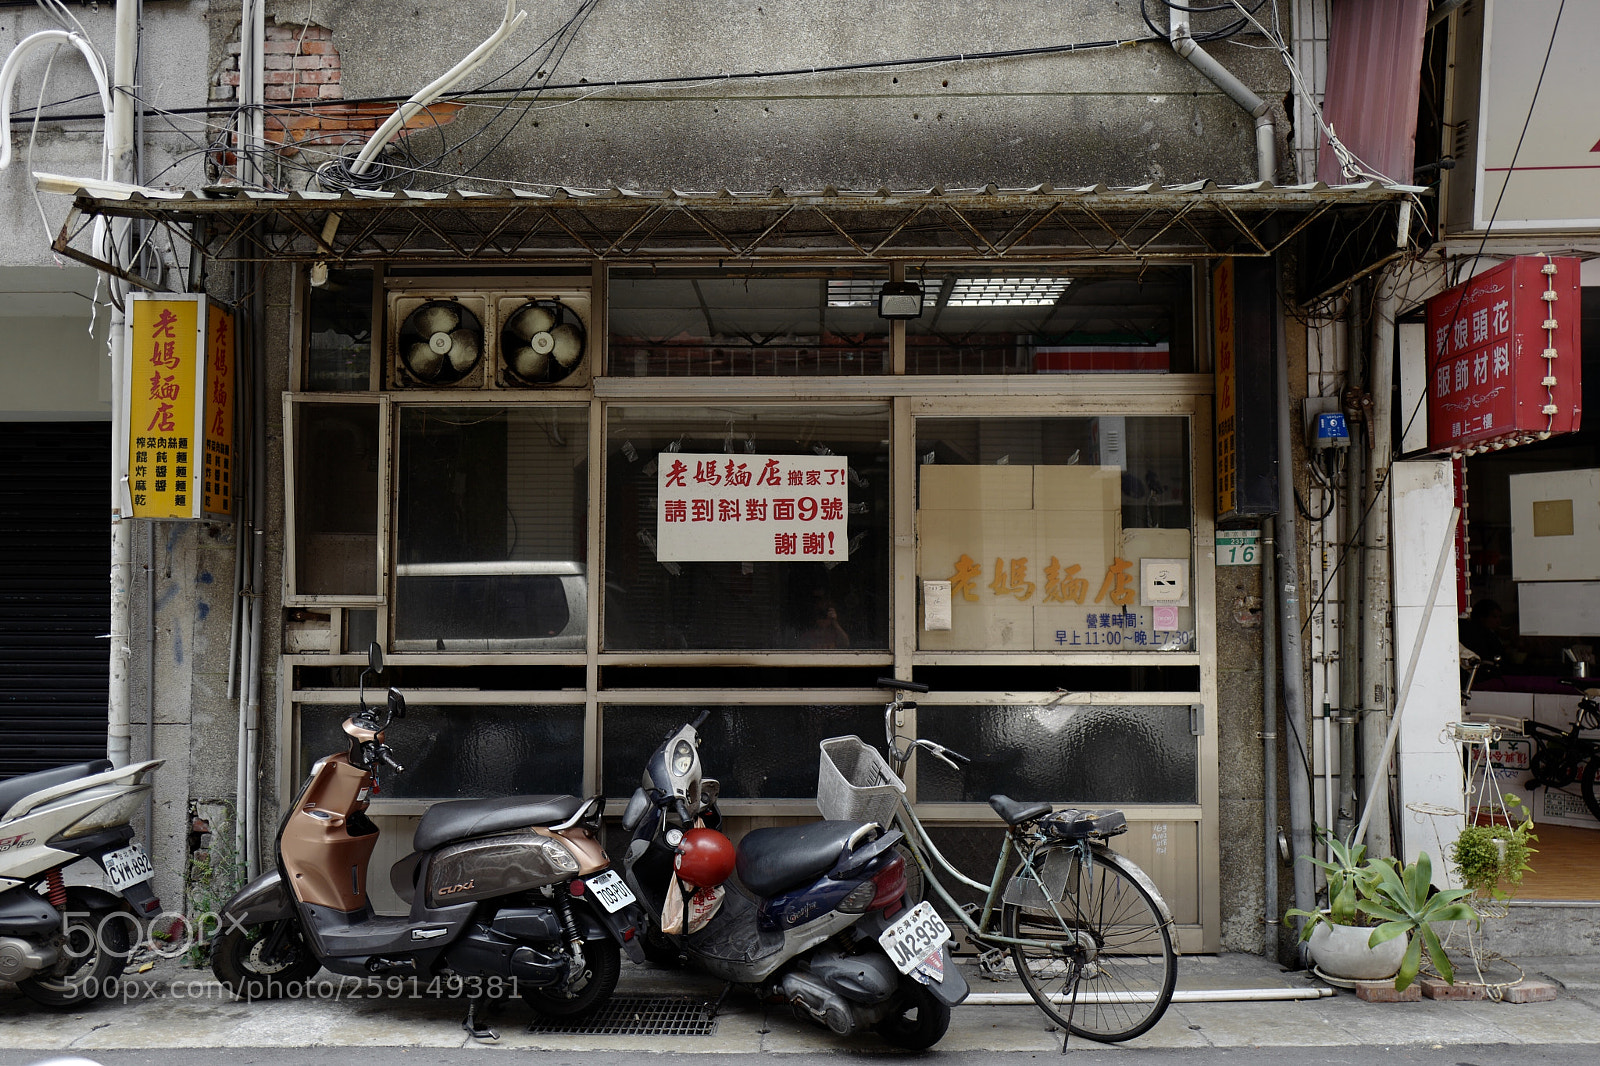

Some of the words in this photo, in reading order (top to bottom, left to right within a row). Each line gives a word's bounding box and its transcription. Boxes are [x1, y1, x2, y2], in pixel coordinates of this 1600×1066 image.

[1436, 300, 1509, 356] 新娘頭花
[147, 308, 181, 432] 老媽麵店
[211, 316, 228, 437] 老媽麵店
[1437, 342, 1510, 399] 服飾材料
[136, 437, 188, 449] 榨菜肉絲麵
[665, 458, 781, 488] 老媽麵店
[664, 496, 844, 523] 請到斜對面9號
[774, 531, 835, 556] 謝謝!
[1228, 546, 1255, 563] 16
[947, 554, 1136, 606] 老媽麵店
[893, 915, 945, 967] JA2-936
